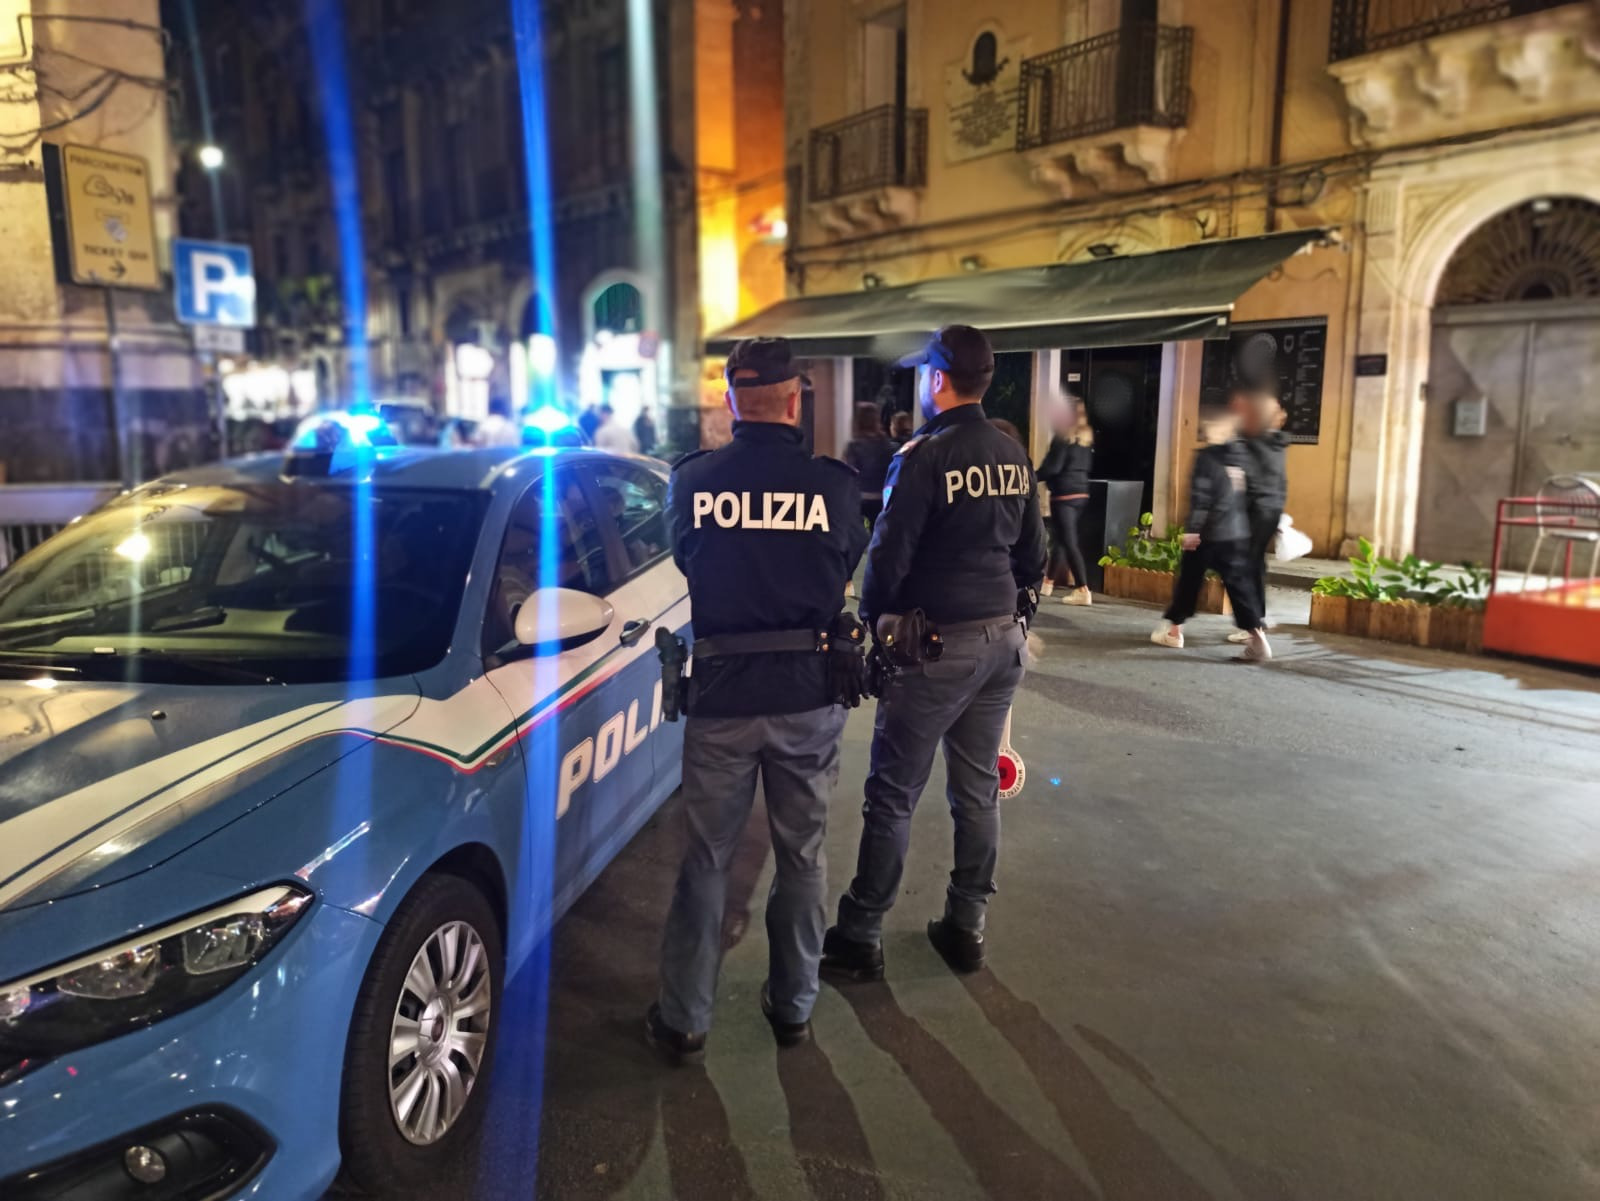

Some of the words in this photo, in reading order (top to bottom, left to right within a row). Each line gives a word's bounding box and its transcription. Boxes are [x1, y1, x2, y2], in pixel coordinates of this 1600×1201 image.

[190, 251, 236, 314] P
[946, 464, 1030, 504] POLIZIA
[693, 491, 830, 532] POLIZIA
[556, 679, 665, 820] POLI
